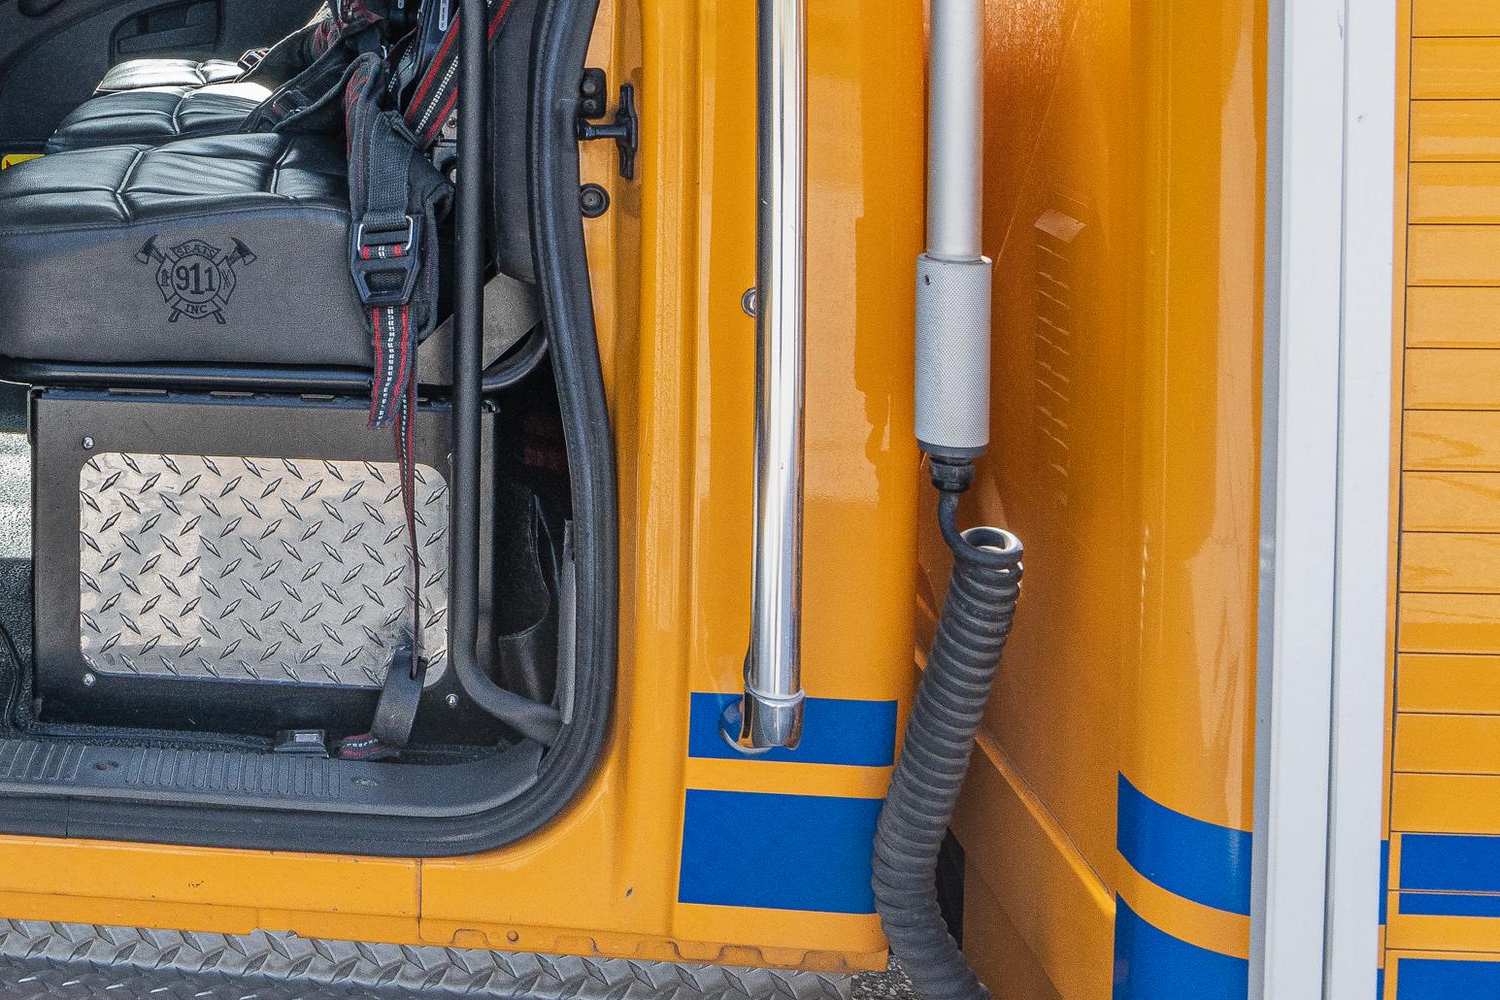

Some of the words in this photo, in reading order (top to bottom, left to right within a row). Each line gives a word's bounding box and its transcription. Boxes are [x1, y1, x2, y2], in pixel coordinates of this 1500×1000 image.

[177, 244, 215, 257] SEATS
[176, 263, 217, 294] 911
[185, 304, 208, 314] INC
